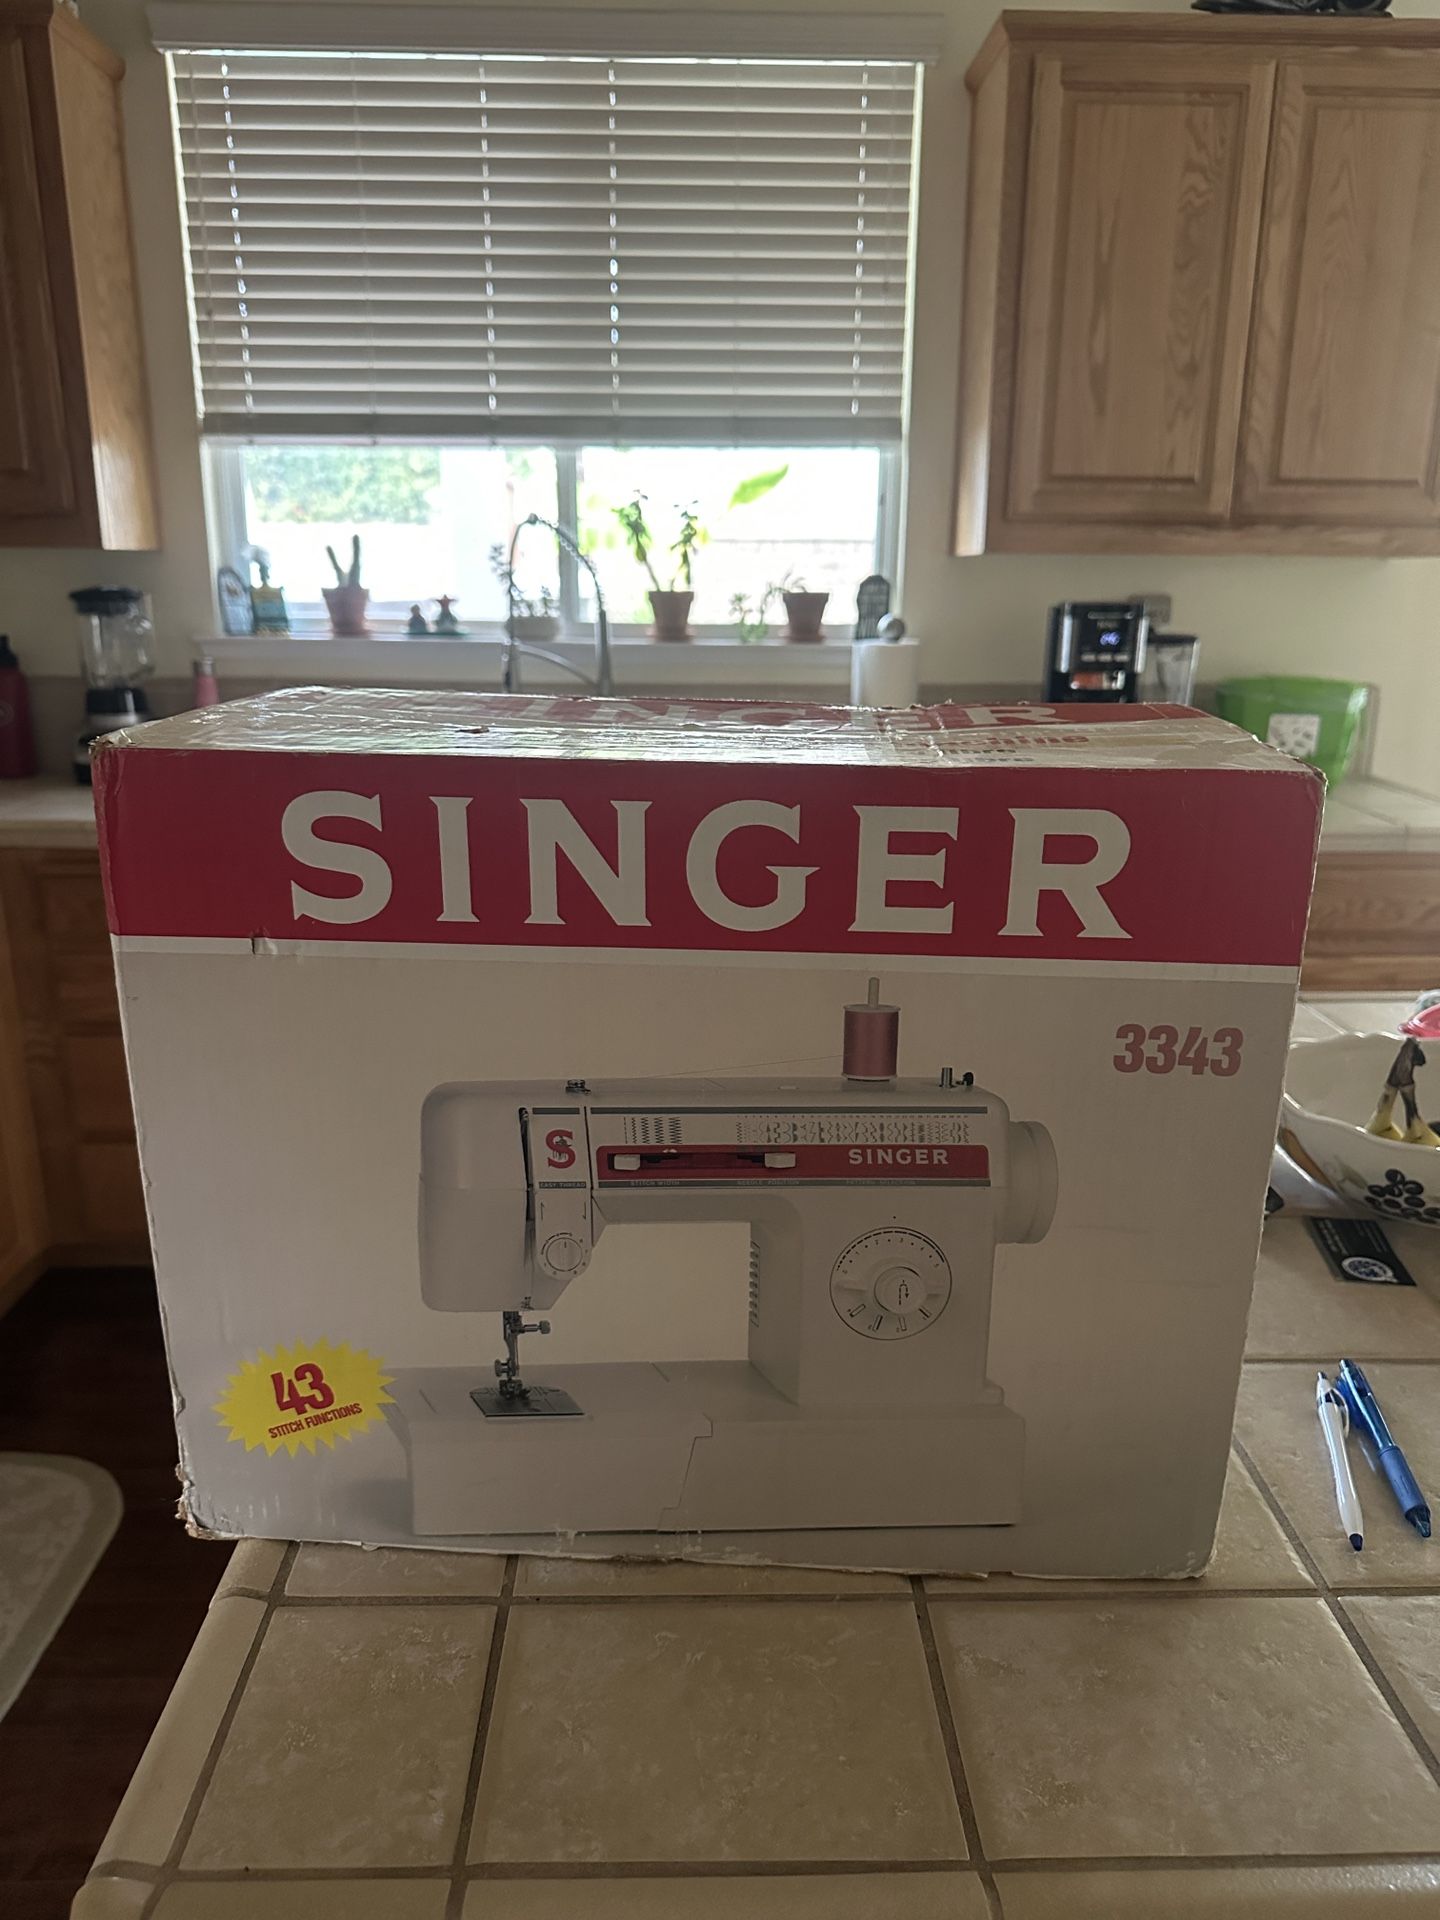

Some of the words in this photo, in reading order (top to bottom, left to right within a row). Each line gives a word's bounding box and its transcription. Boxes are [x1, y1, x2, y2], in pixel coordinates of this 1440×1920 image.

[280, 790, 1134, 939] SINGER
[1112, 1023, 1244, 1077] 3343
[848, 1148, 949, 1165] SINGER
[270, 1363, 334, 1415] 43
[268, 1420, 305, 1439] STITCH
[304, 1403, 363, 1428] FUNCTIONS
